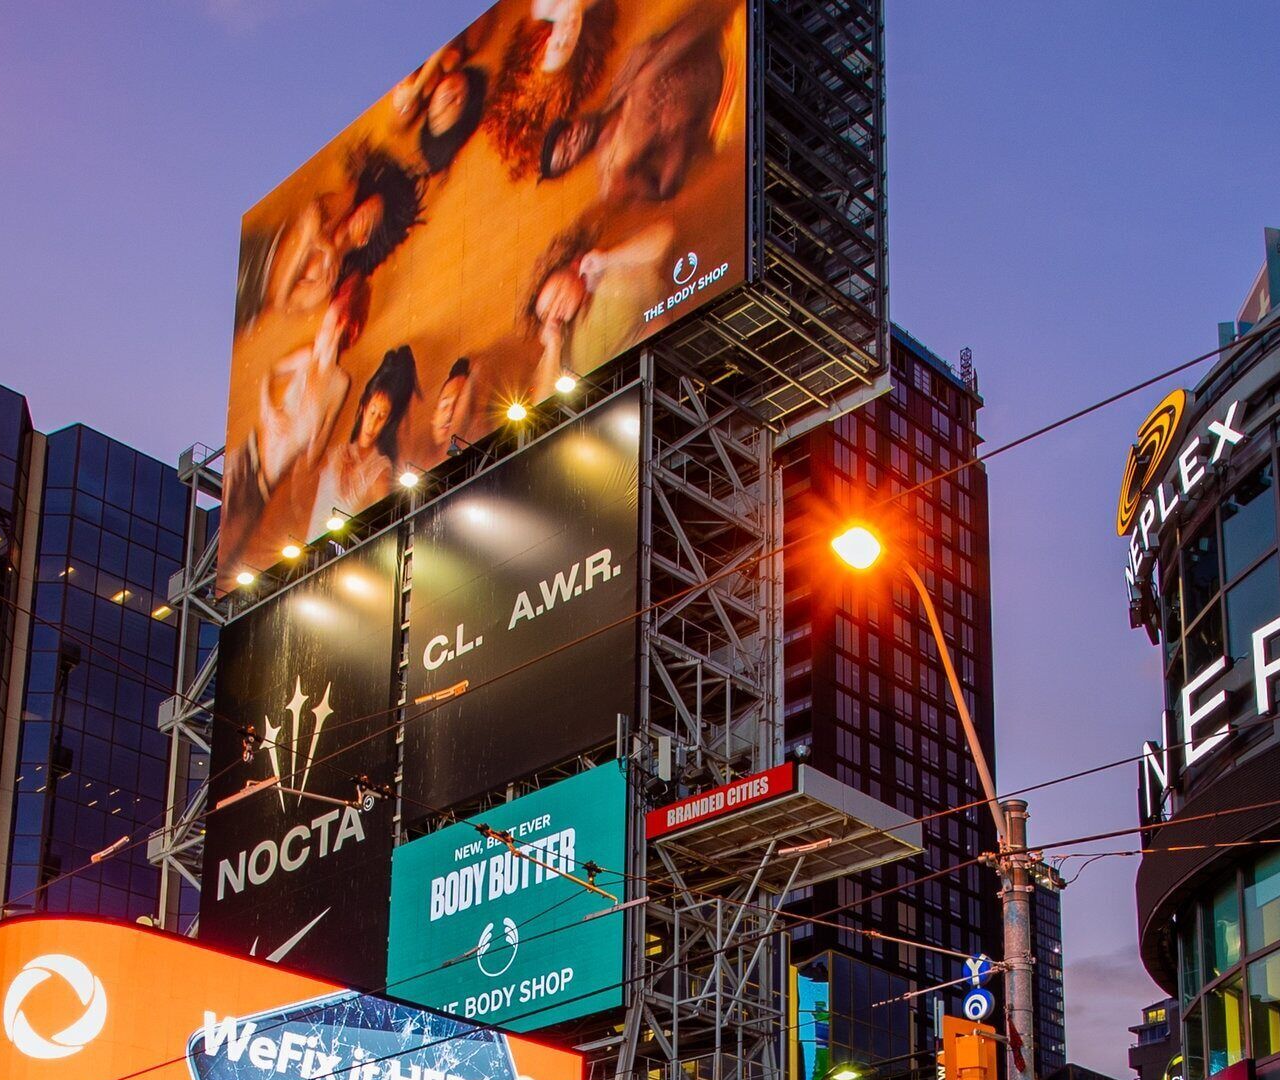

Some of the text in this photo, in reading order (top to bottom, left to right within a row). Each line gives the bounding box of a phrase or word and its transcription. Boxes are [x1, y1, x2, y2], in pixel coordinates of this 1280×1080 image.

[643, 262, 729, 322] THE BODY SHOP
[422, 548, 622, 671] C.L. A.W.R.
[666, 776, 769, 827] BRANDED CITIES
[217, 806, 366, 901] NOCTA
[454, 814, 551, 862] NEW, BET EVER
[429, 827, 576, 922] BODY BUTTER
[464, 984, 516, 1019] BODY
[518, 966, 574, 1003] SHOP
